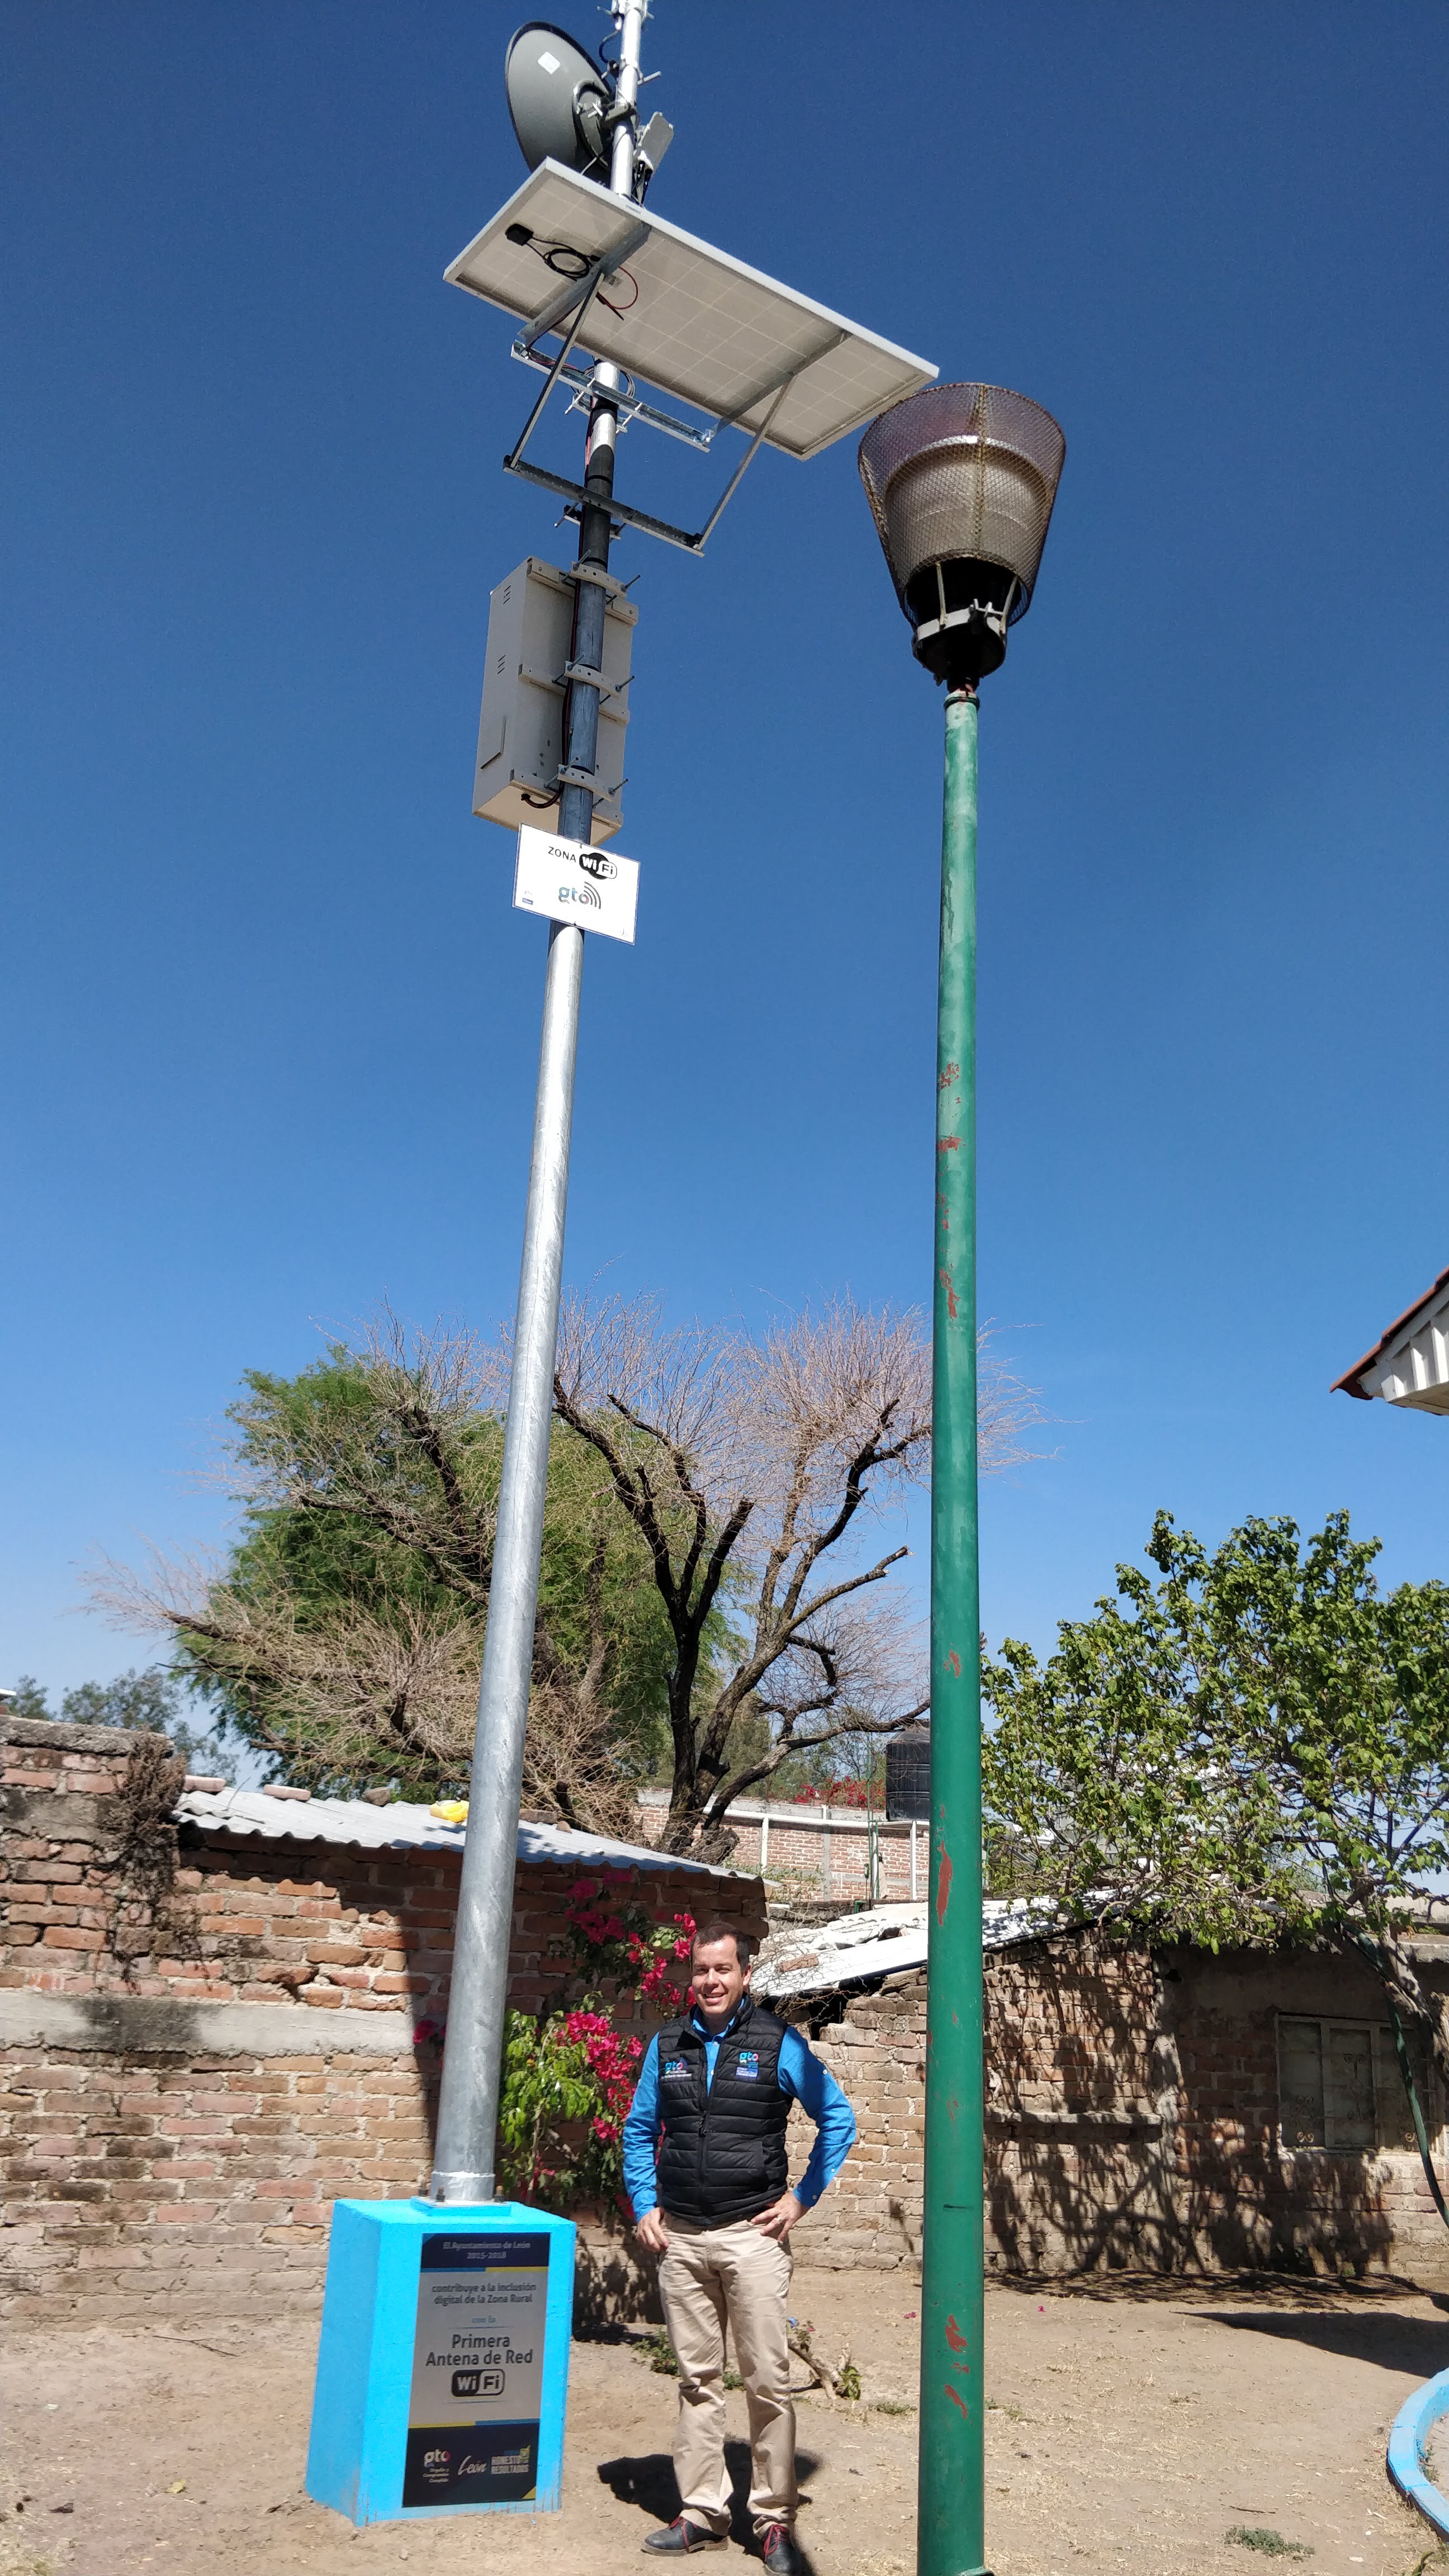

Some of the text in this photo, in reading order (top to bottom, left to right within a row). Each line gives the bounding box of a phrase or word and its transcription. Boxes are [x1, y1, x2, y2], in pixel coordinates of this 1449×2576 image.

[548, 846, 576, 863] ZONA
[558, 887, 589, 905] gto
[432, 2284, 479, 2294] contribuye
[487, 2283, 496, 2291] la
[497, 2283, 537, 2291] inclusión
[434, 2295, 463, 2307] digital
[477, 2295, 485, 2303] la
[487, 2294, 508, 2303] Zona
[510, 2294, 533, 2303] Rural
[452, 2333, 510, 2348] Primera
[425, 2348, 534, 2366] Antena de Red
[424, 2449, 451, 2468] gto
[457, 2455, 487, 2476] León
